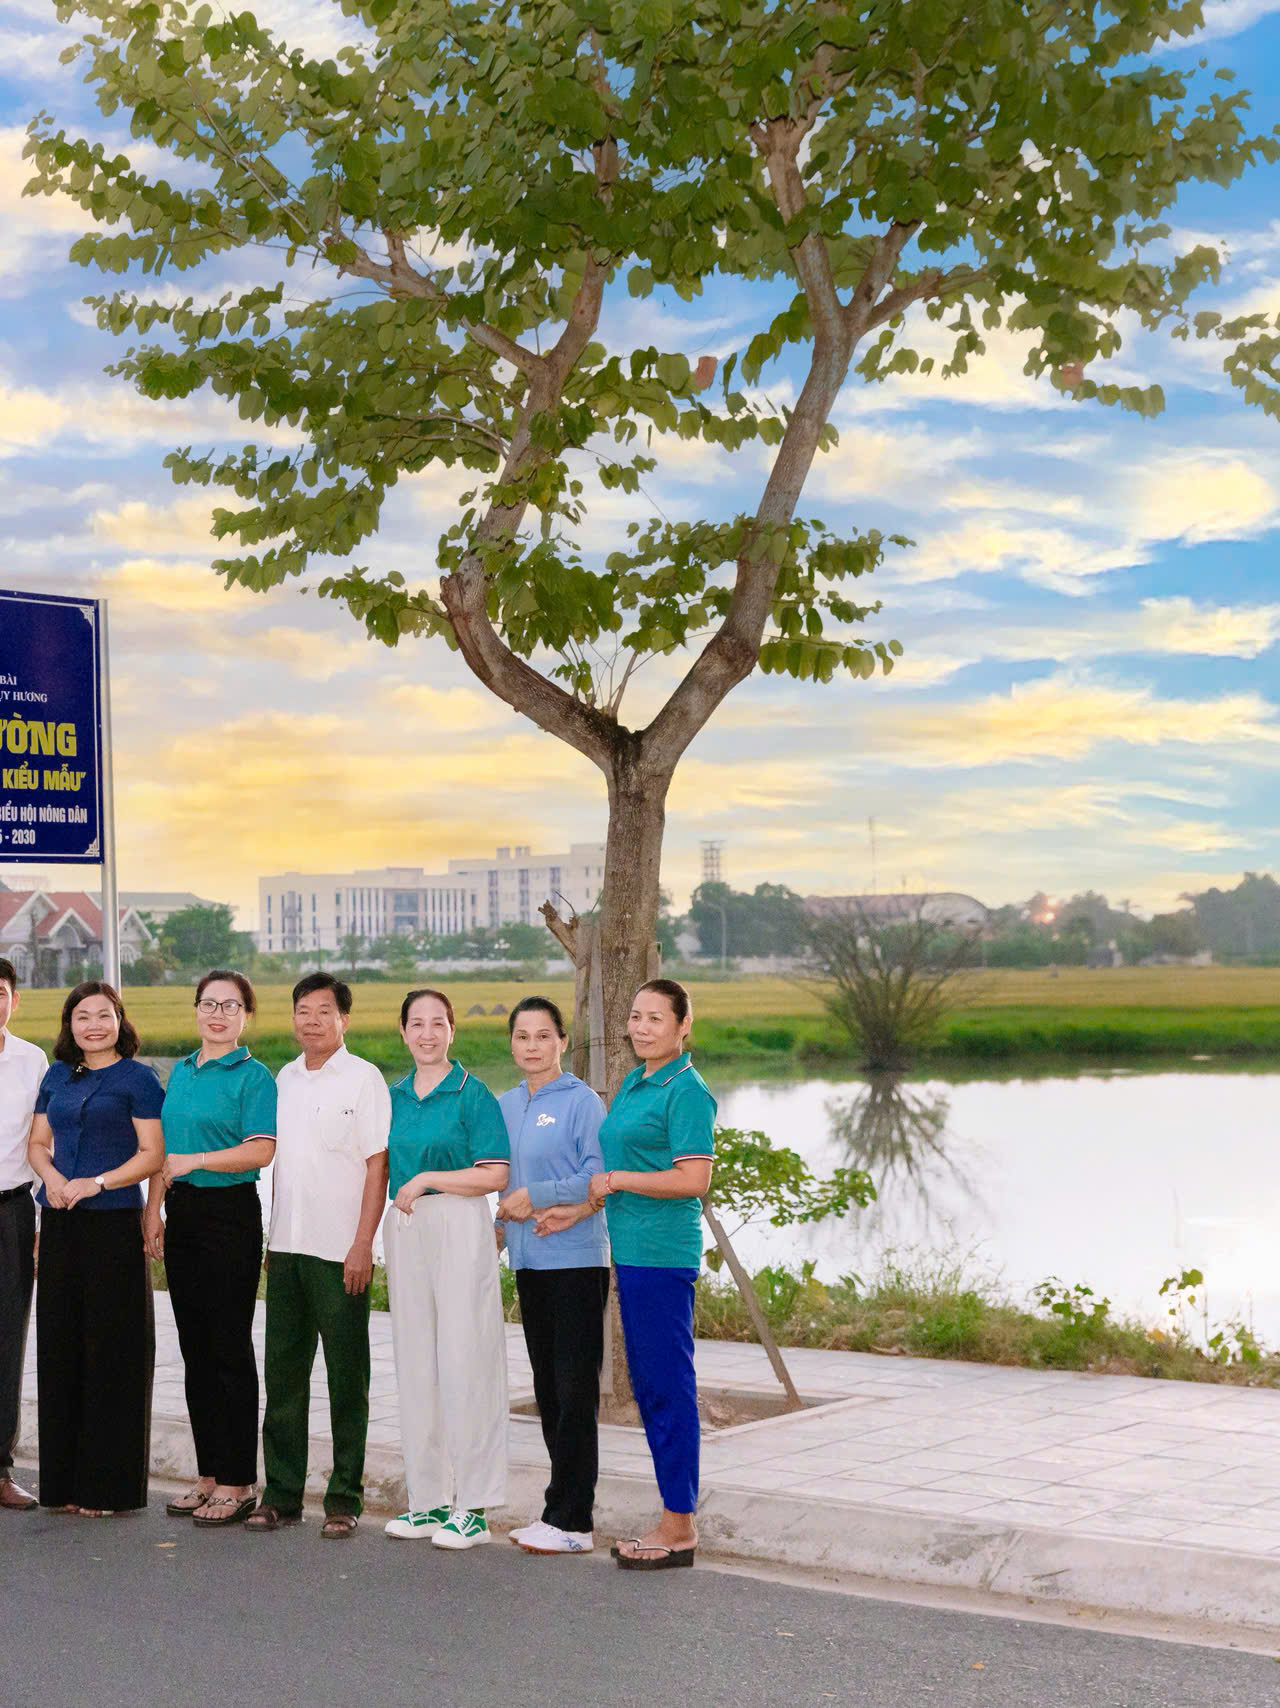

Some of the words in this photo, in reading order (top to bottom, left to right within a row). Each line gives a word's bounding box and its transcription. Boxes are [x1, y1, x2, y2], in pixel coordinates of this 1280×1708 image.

[0, 672, 17, 685] BÀI
[13, 691, 47, 702] HƯƠNG
[2, 761, 38, 790] KIỂU
[20, 804, 37, 826] HỘI
[39, 804, 66, 823] NÔNG
[68, 805, 88, 824] DÂN
[11, 829, 36, 844] 2030
